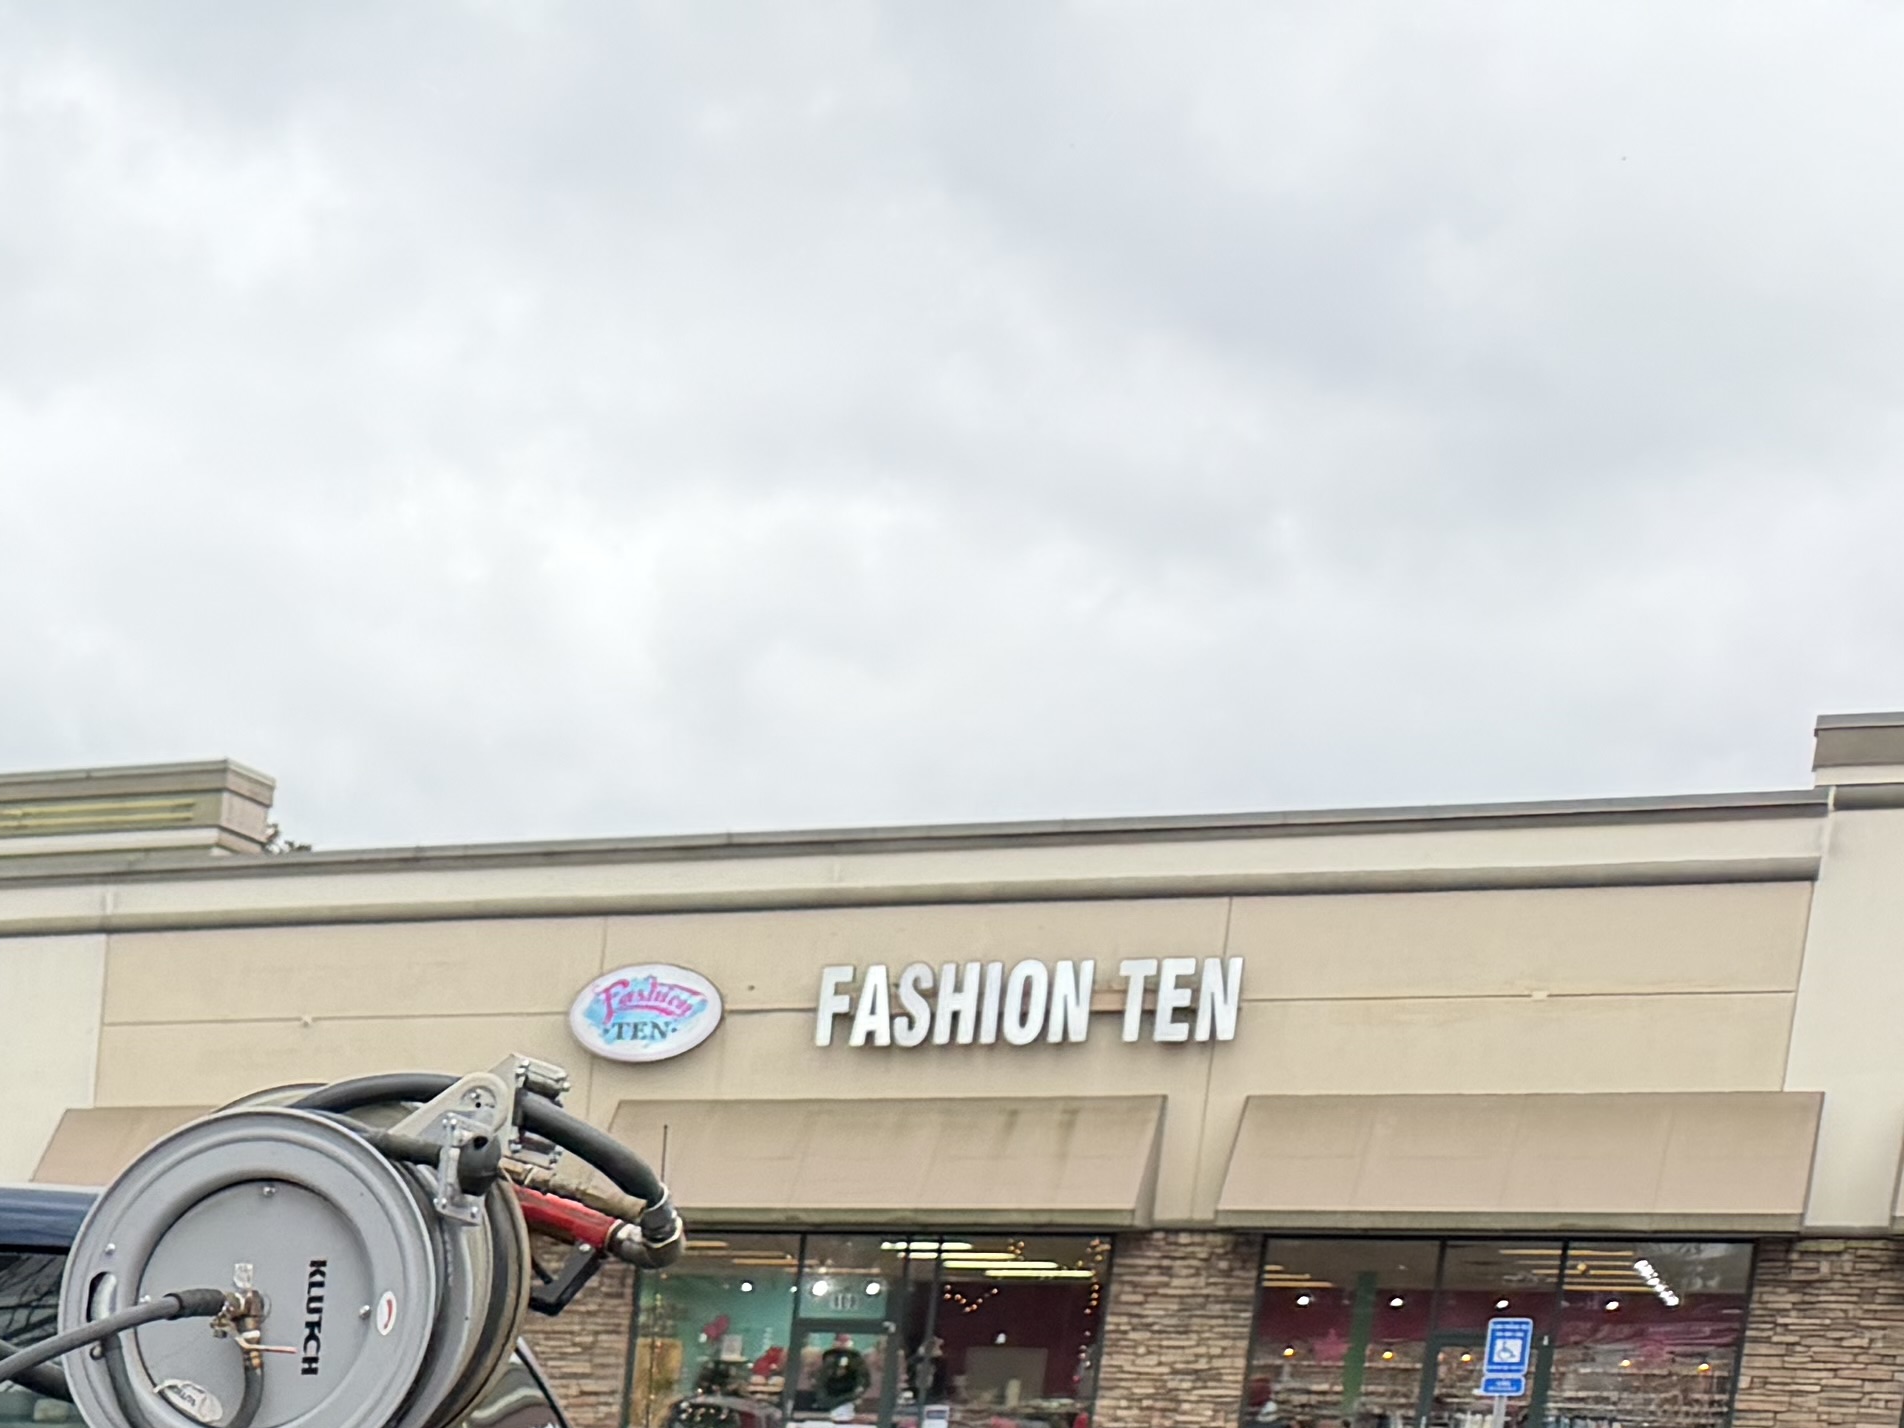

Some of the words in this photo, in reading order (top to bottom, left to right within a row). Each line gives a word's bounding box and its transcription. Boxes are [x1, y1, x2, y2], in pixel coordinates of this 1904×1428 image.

[593, 975, 708, 1024] Fashion
[815, 958, 1094, 1048] FASHION
[1119, 957, 1244, 1042] TEN
[301, 1260, 327, 1375] KLUTCH
